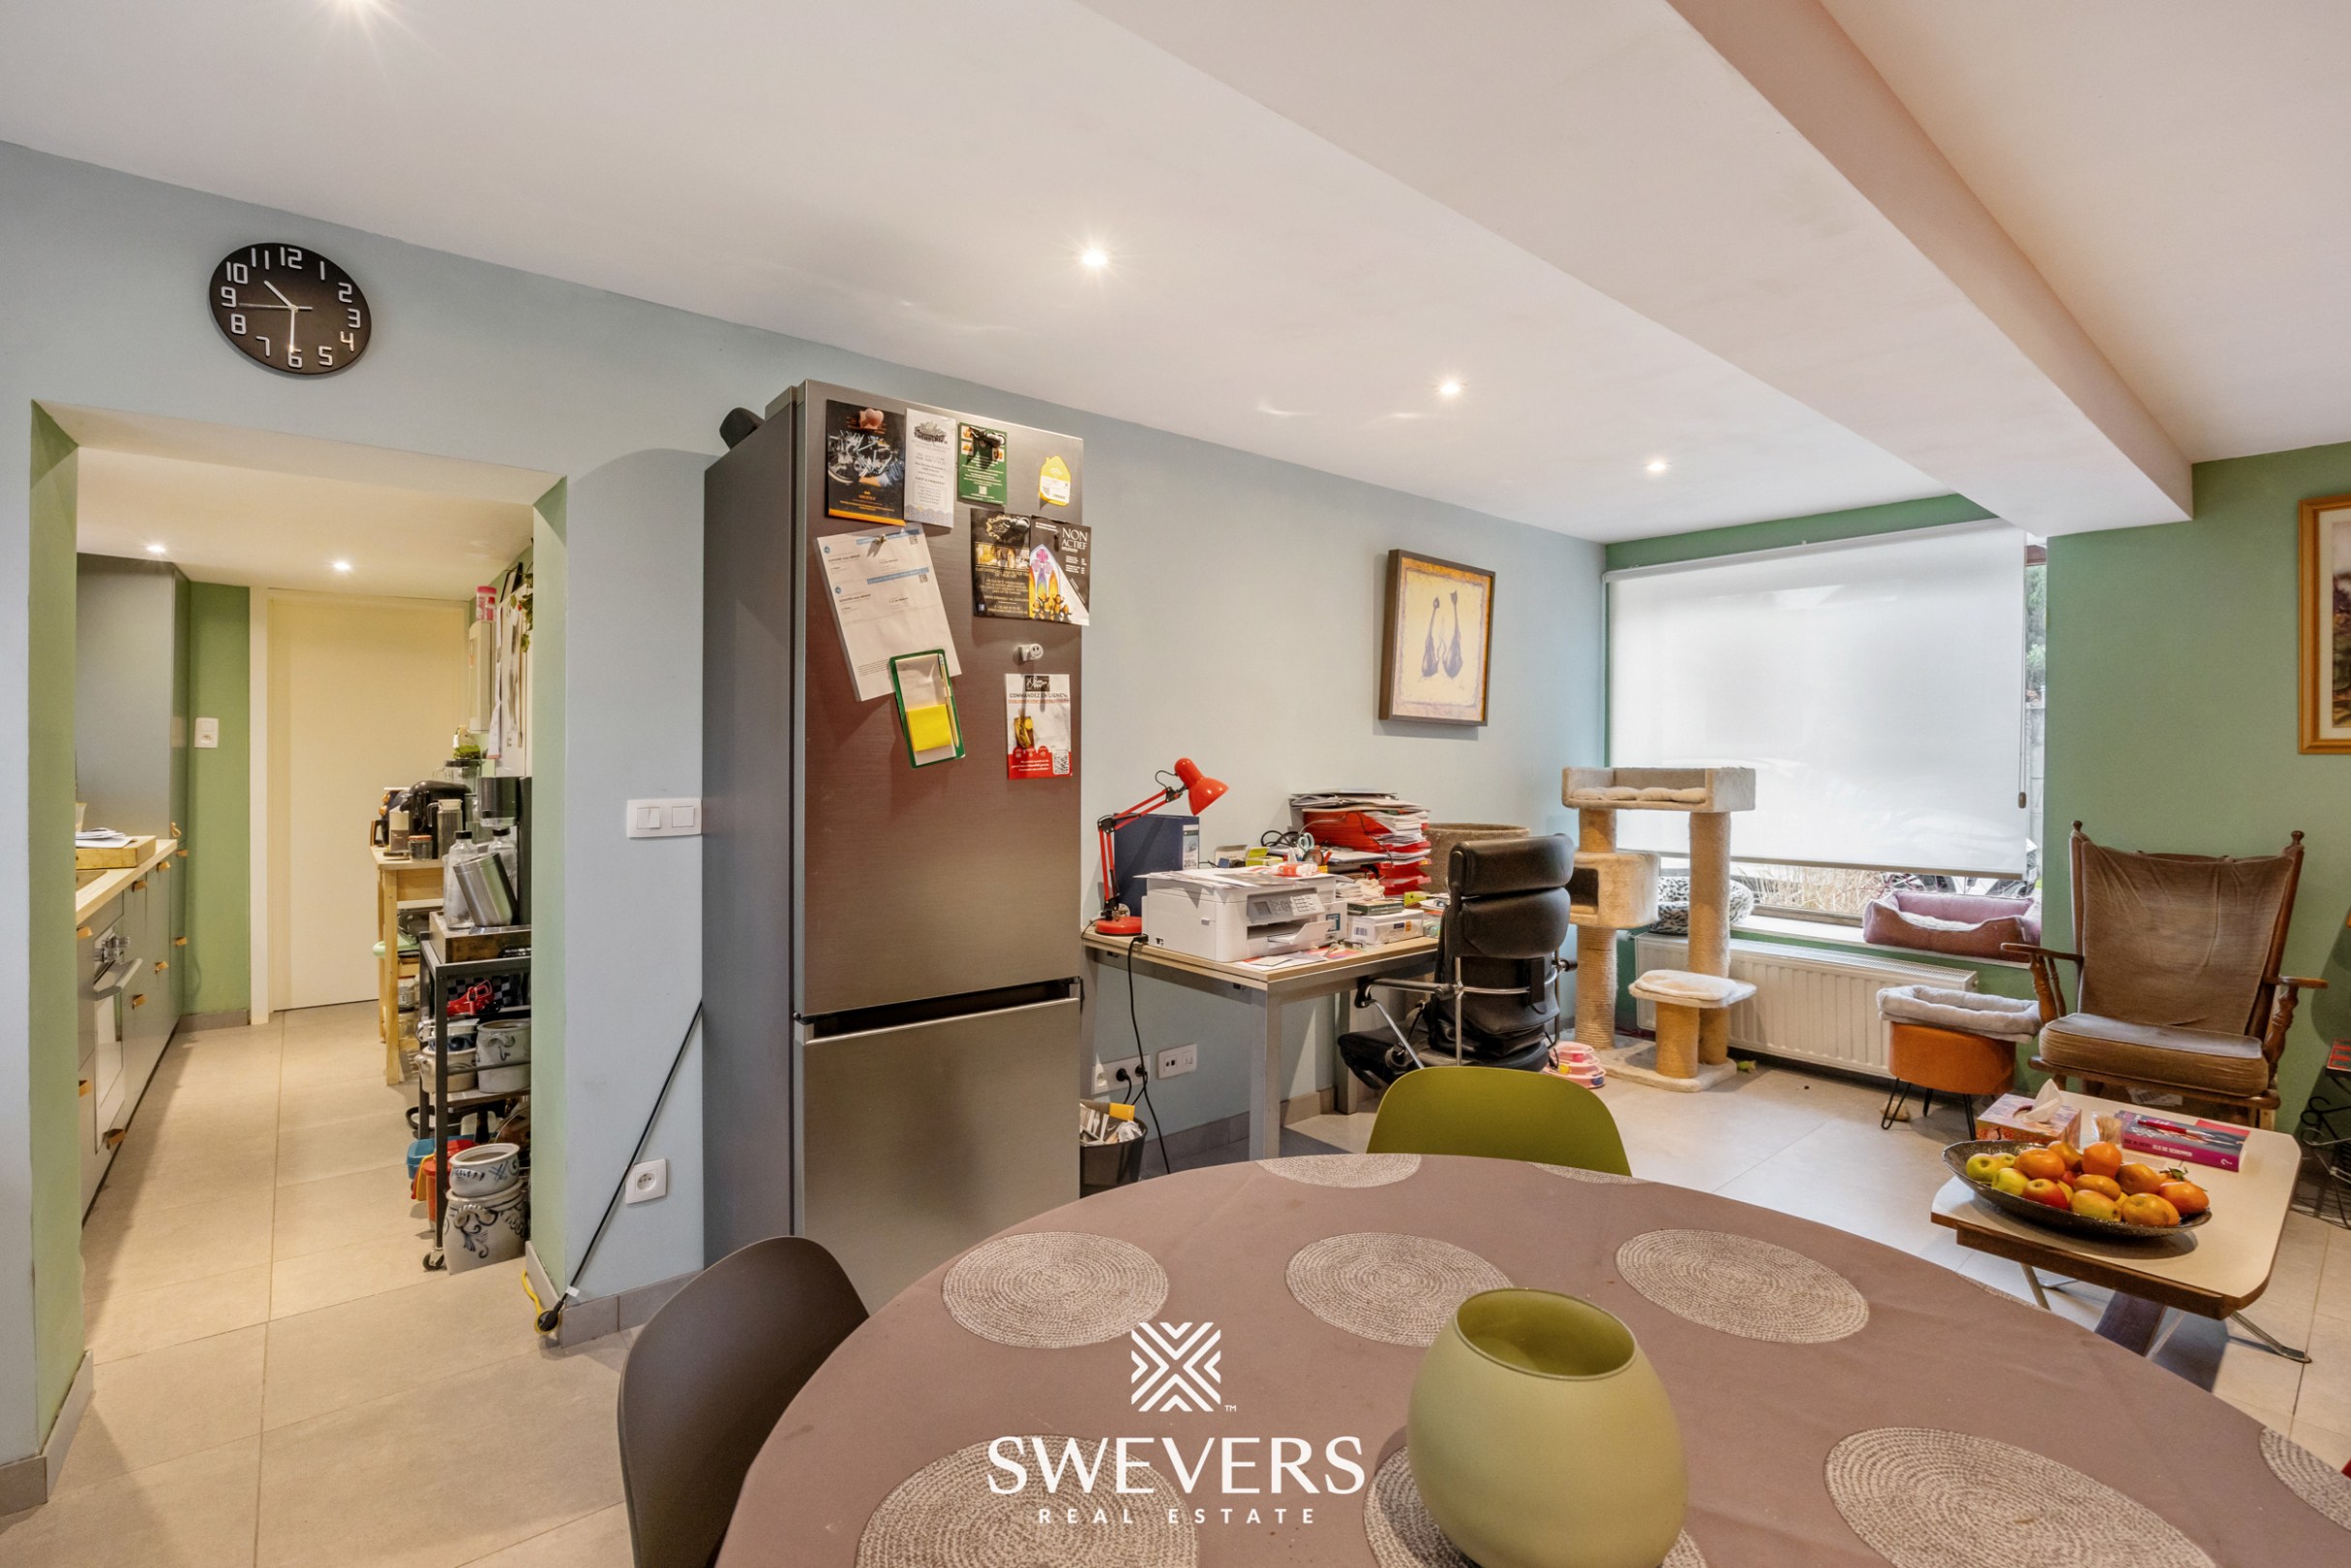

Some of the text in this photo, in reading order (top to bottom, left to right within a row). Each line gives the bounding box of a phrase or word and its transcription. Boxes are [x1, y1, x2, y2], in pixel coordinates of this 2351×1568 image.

[251, 247, 270, 270] 11
[280, 246, 303, 270] 12
[226, 261, 249, 285] 10
[319, 260, 325, 281] 1
[221, 286, 236, 308] 9
[338, 282, 352, 303] 2
[230, 313, 247, 335] 8
[347, 308, 361, 329] 3
[256, 335, 270, 357] 7
[340, 330, 354, 352] 4
[287, 347, 303, 369] 6
[317, 346, 333, 366] 5
[1061, 538, 1088, 551] ACTIEF
[1062, 527, 1088, 542] NON
[1184, 859, 1197, 868] 20%
